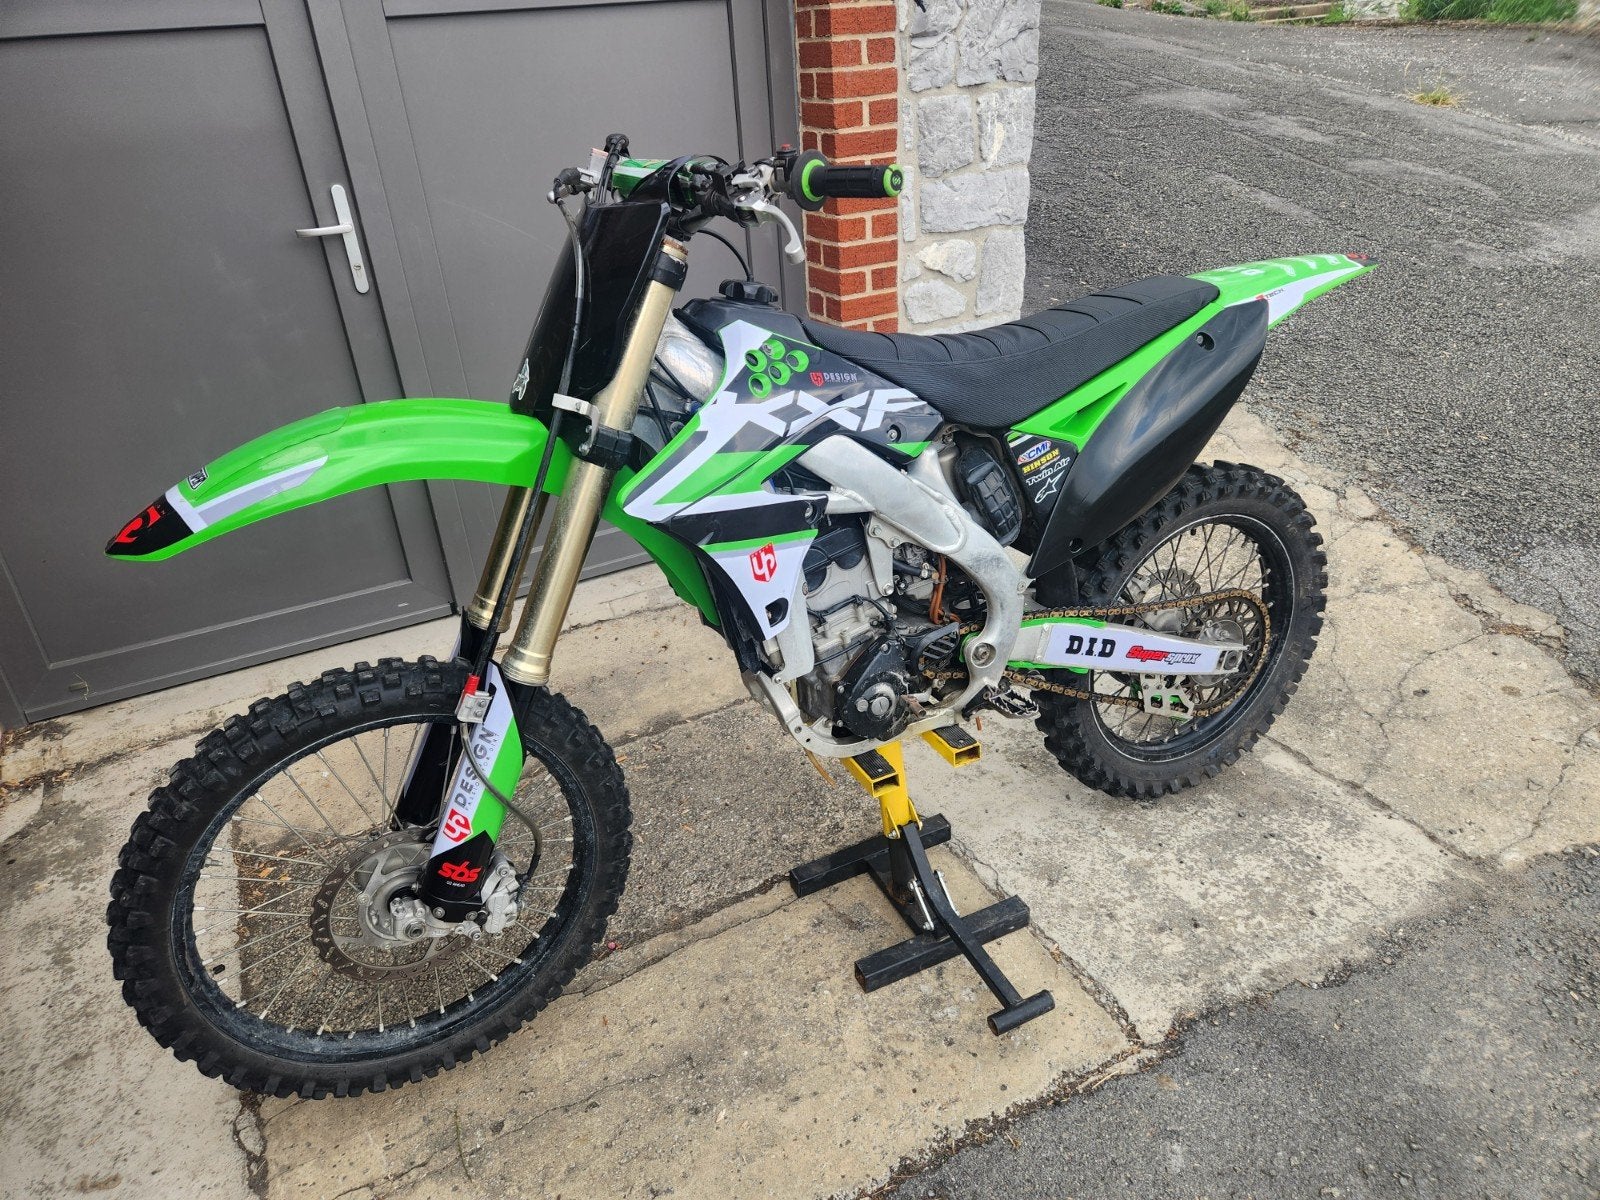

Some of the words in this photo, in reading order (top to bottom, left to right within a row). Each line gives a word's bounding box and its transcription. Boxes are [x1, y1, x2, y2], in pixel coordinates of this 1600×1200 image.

[823, 372, 858, 382] DESIGN
[1022, 447, 1061, 474] HINSON
[1025, 467, 1054, 486] Twin
[1053, 456, 1071, 473] Air
[454, 726, 498, 810] DESGN
[437, 861, 482, 883] sbs
